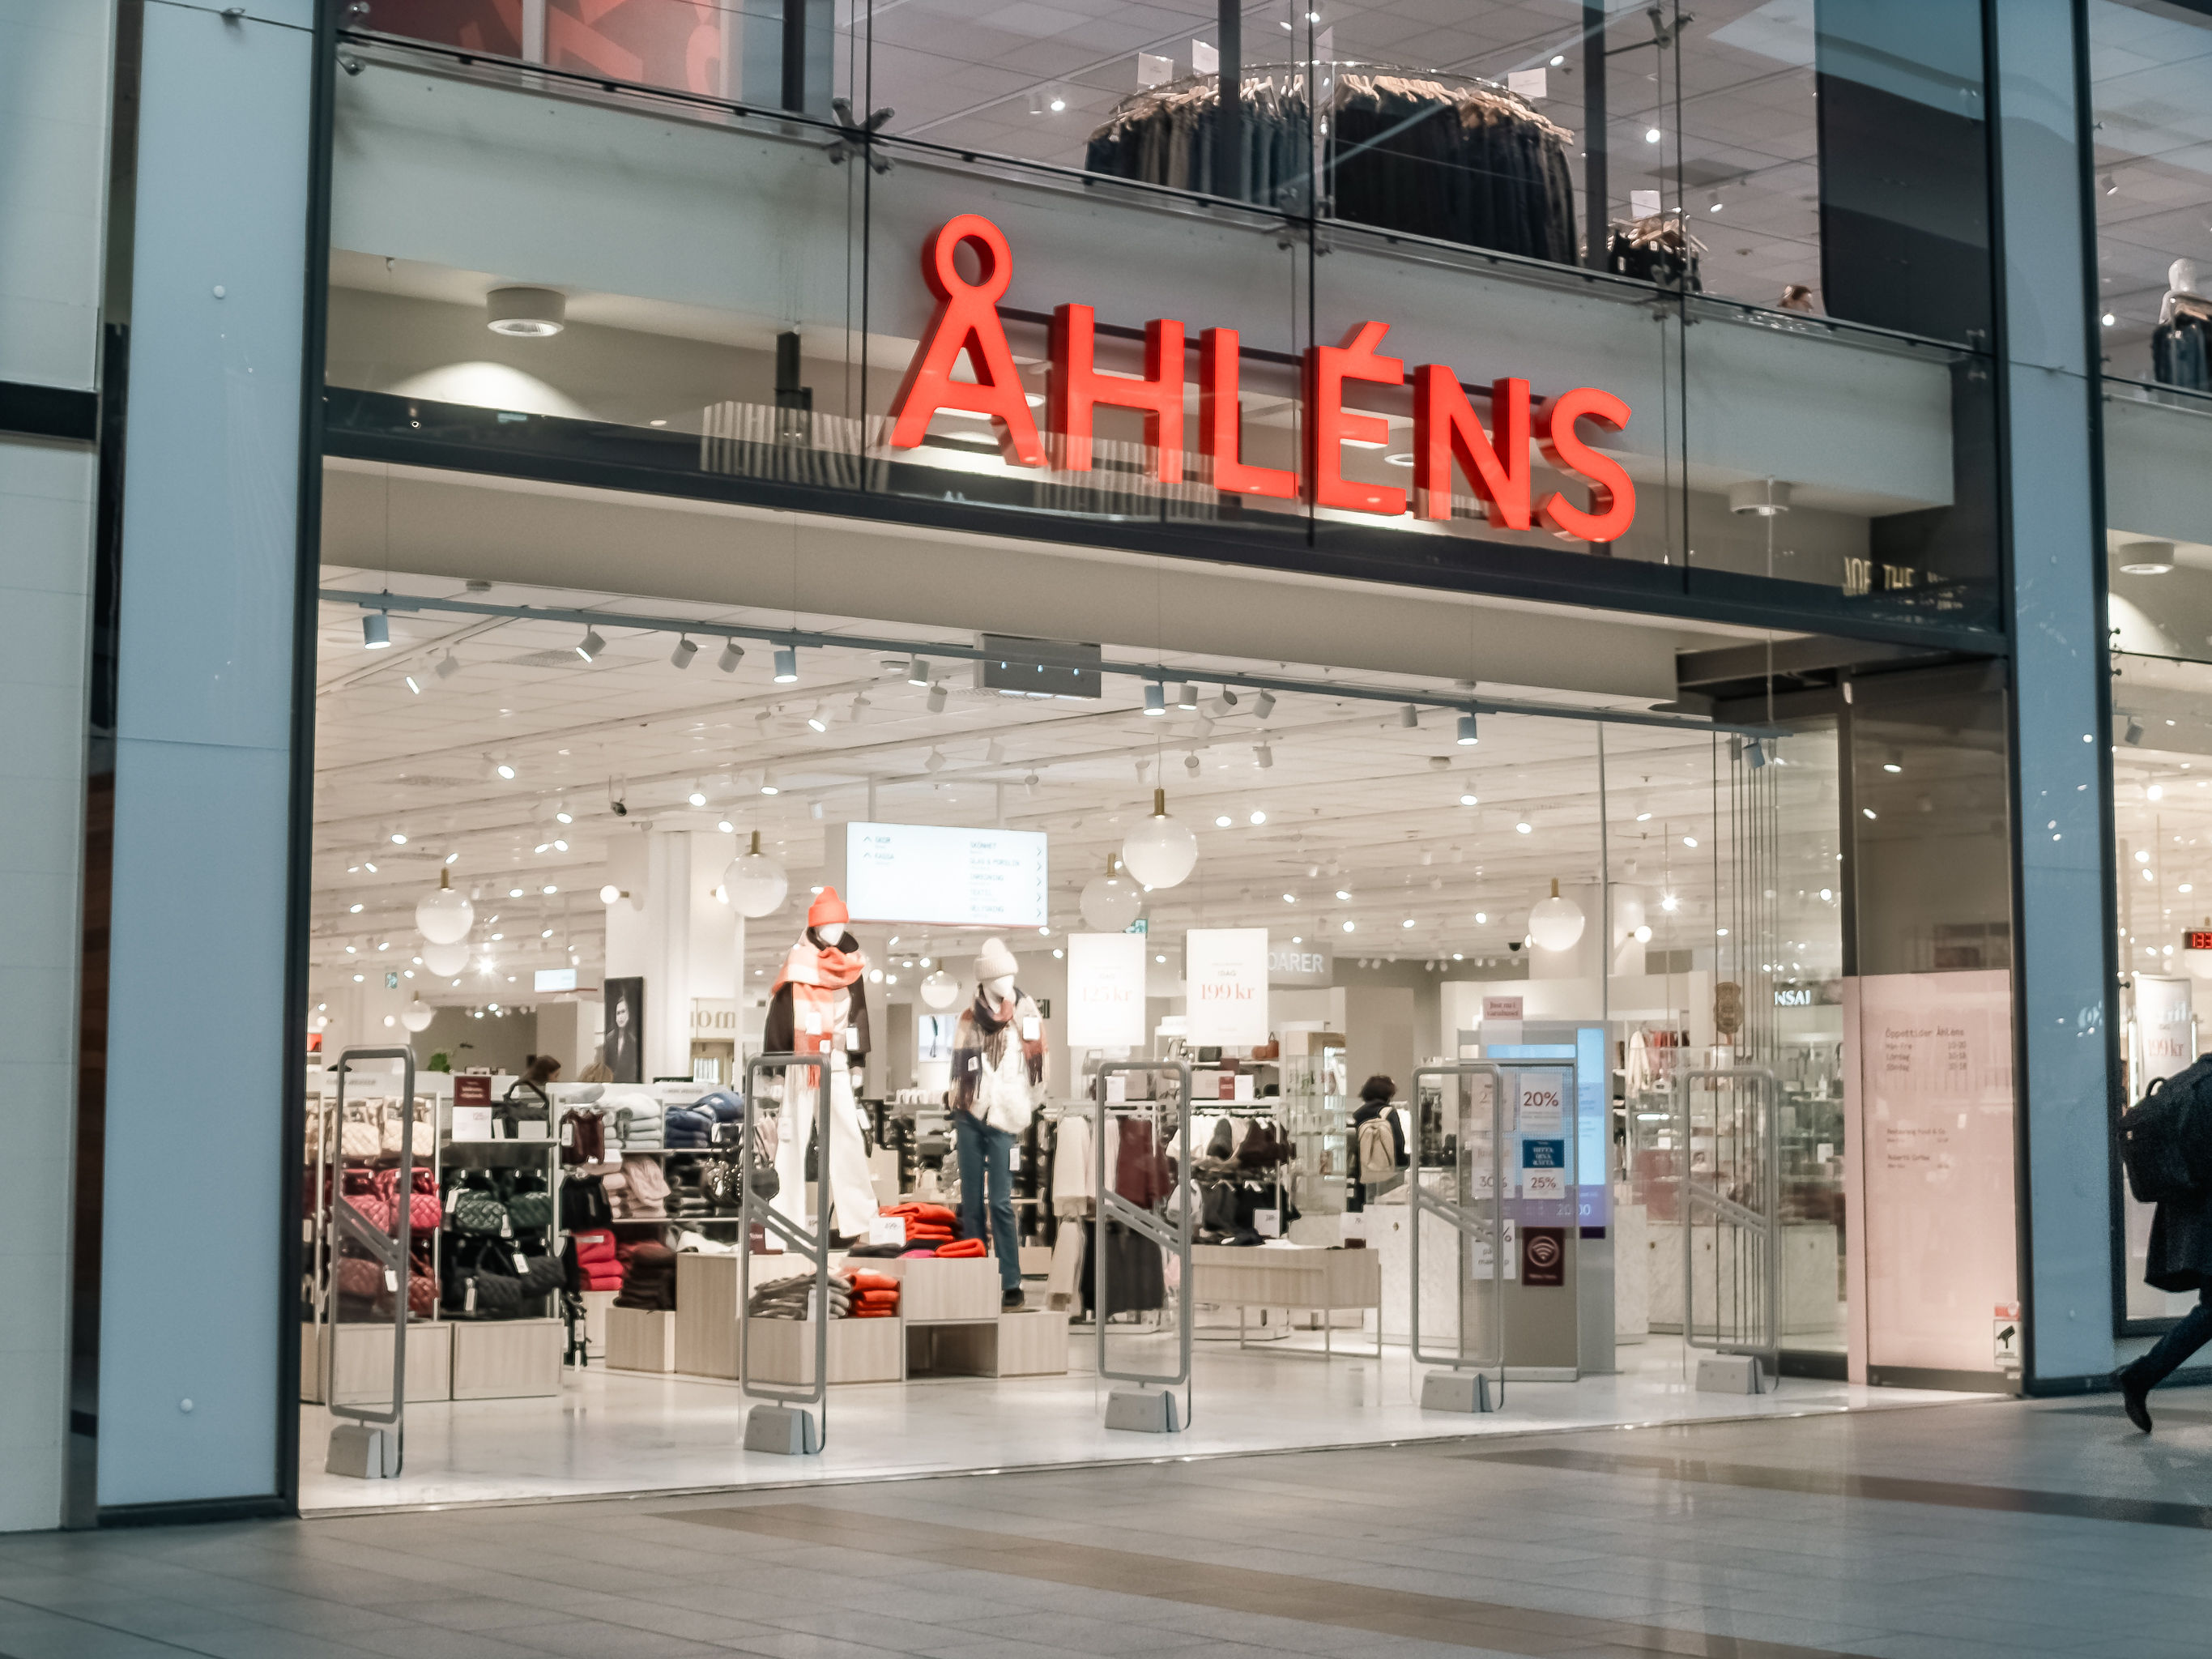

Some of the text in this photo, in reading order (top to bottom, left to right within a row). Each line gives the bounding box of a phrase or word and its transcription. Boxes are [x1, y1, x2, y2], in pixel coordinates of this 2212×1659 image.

[889, 213, 1636, 544] ÅHLÉNS
[1200, 983, 1255, 1000] 199 kr
[1523, 1091, 1559, 1107] 20%
[1530, 1177, 1557, 1188] 25%
